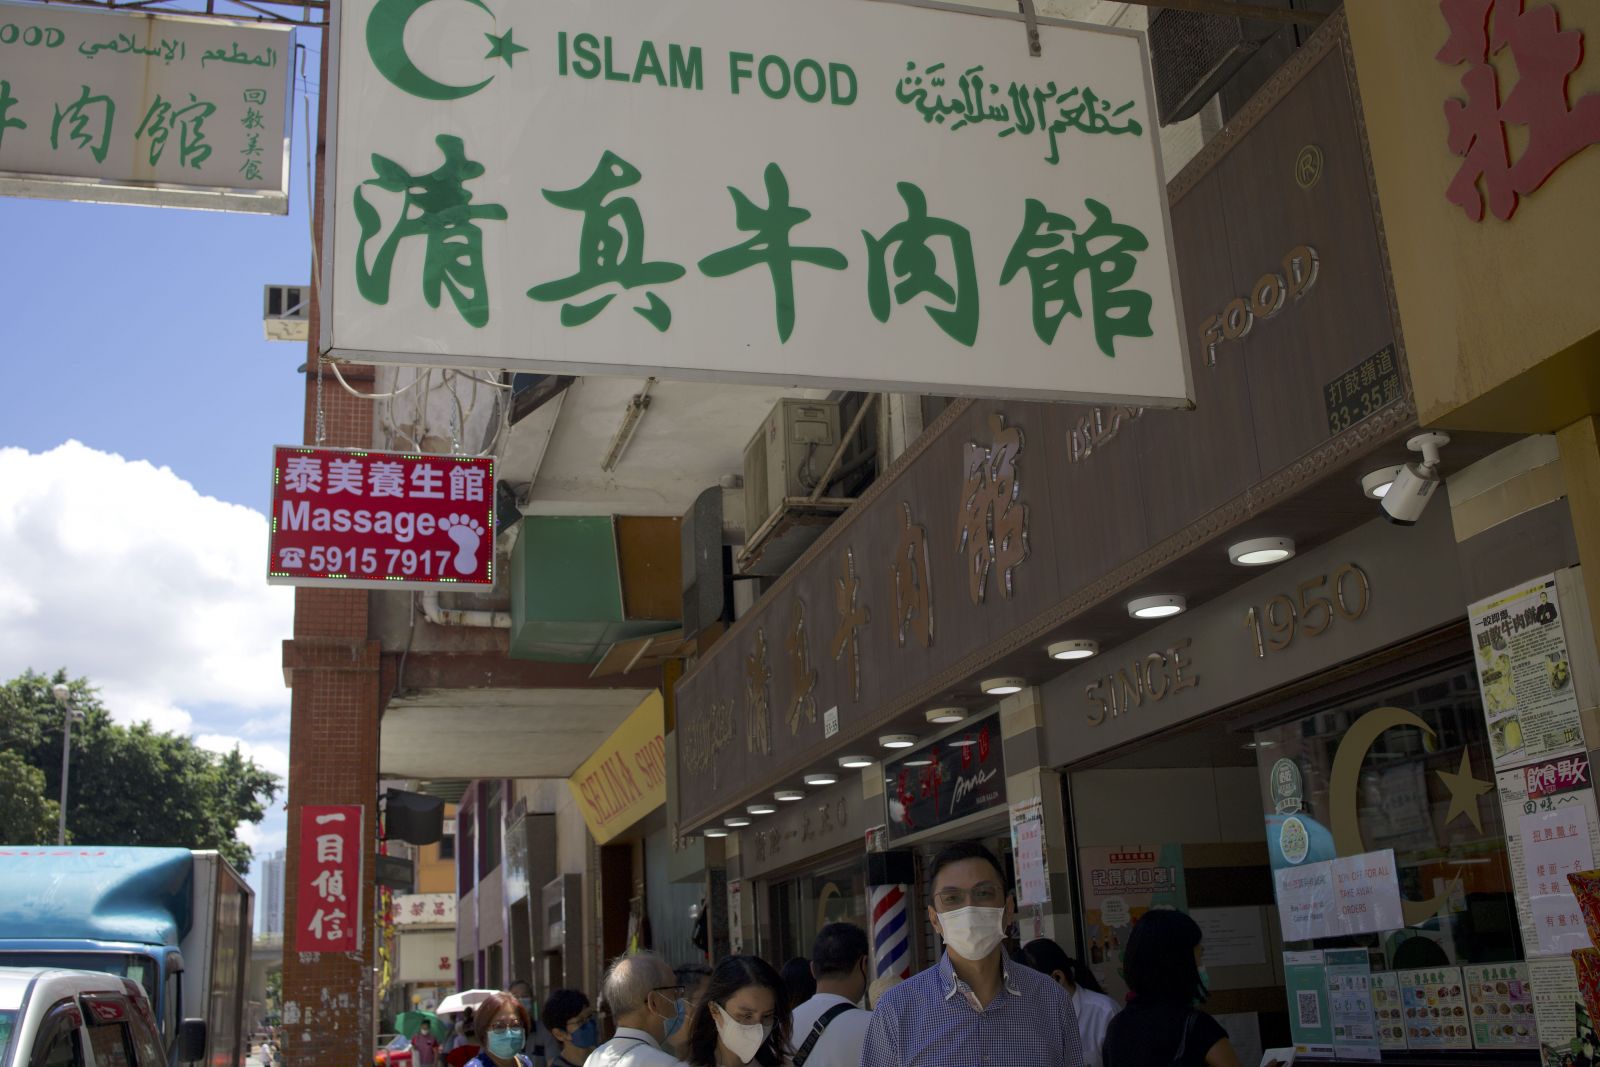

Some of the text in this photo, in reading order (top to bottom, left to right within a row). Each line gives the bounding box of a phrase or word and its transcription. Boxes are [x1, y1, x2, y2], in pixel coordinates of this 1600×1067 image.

[558, 31, 858, 107] ISLAM FOOD
[240, 88, 268, 182] 回教美食
[353, 133, 1155, 358] 清真牛肉館
[1200, 245, 1321, 367] FOOD
[284, 456, 486, 502] 泰美養生館
[281, 500, 436, 543] Massage
[308, 546, 451, 576] 5915 7917
[1082, 562, 1370, 728] SINCE 1950
[1527, 757, 1589, 793] 飲食男女
